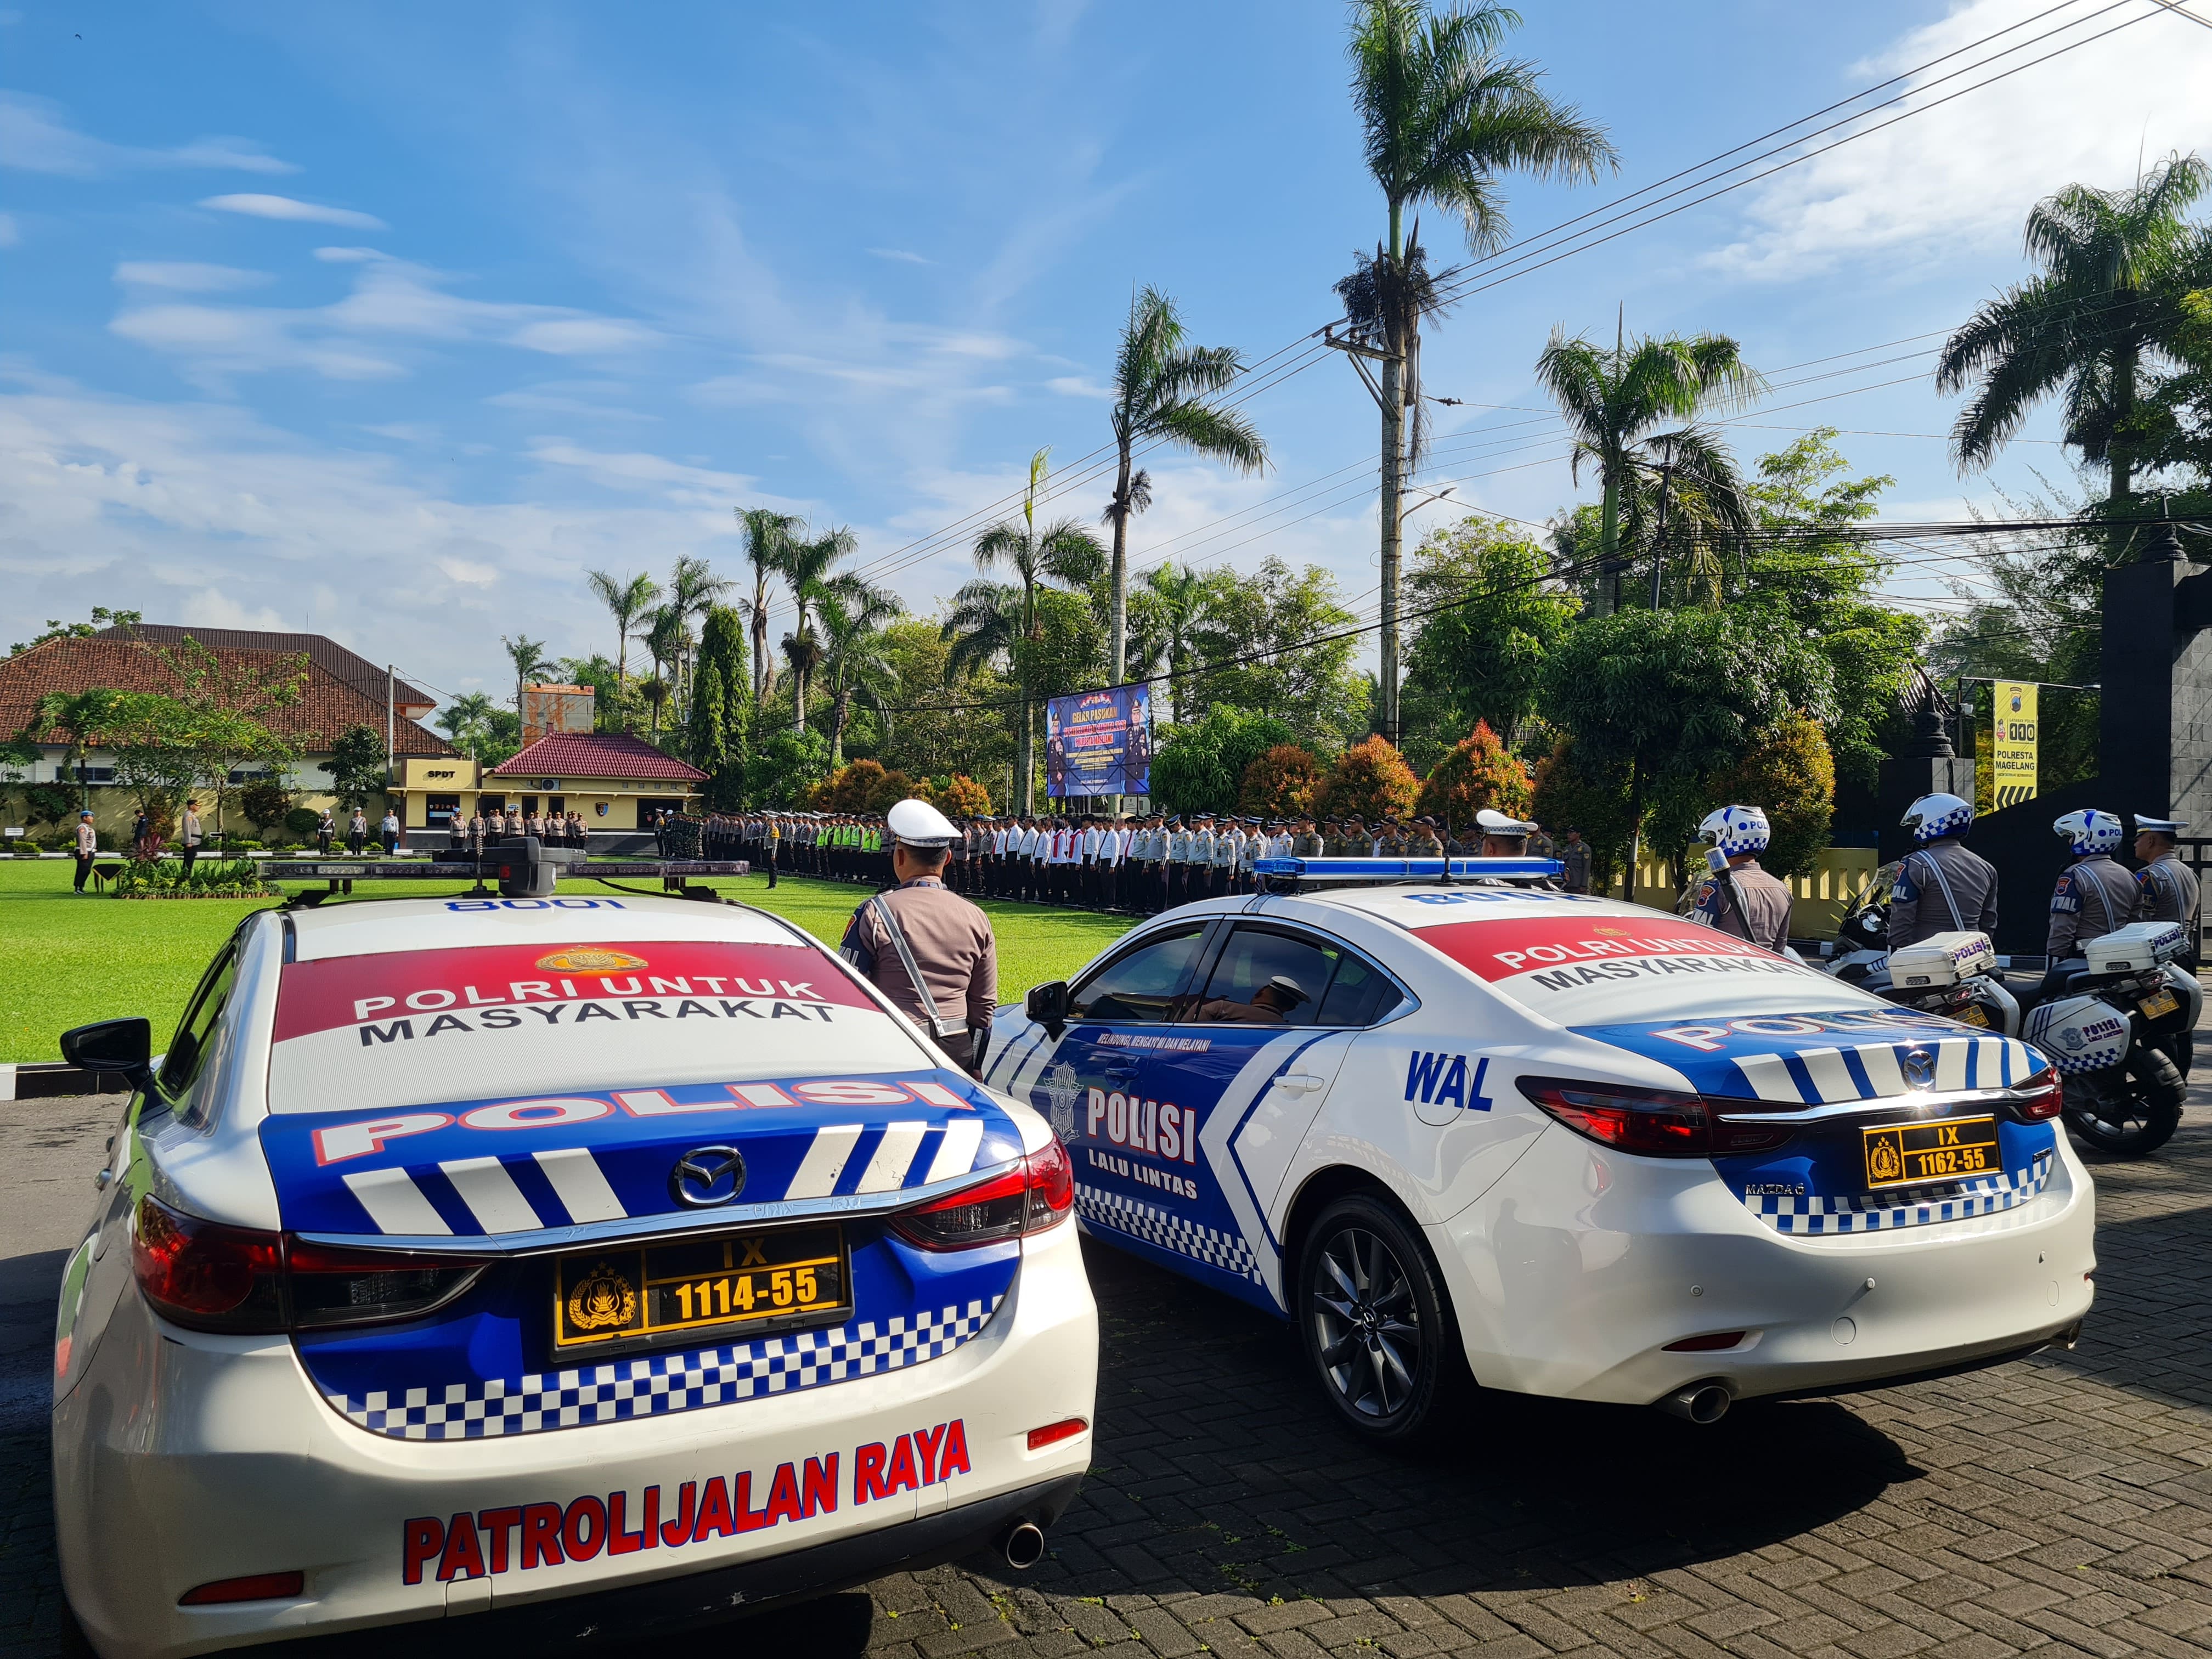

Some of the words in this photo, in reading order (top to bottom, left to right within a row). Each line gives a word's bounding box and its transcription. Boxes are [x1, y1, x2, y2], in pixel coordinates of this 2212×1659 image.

[1073, 710, 1090, 723] GELAR
[1091, 706, 1118, 721] PASUKAN
[2010, 724, 2034, 741] 110
[1995, 761, 2035, 770] MAGELANG
[1997, 751, 2033, 760] POLRESTA
[444, 899, 627, 911] 8001
[1492, 939, 1635, 970] POLRI
[1628, 938, 1775, 958] UNTUK
[1954, 937, 1987, 961] POLISI
[1530, 957, 1814, 991] MASYARAKAT
[353, 977, 578, 1022] POLRI
[603, 975, 826, 1001] UNTUK
[358, 1000, 837, 1048] MASYARAKAT
[2083, 1018, 2121, 1037] POLISI
[1131, 1035, 1166, 1049] MENGAYOMI
[1164, 1037, 1180, 1049] DAN
[1178, 1038, 1211, 1052] MELAYANI
[1405, 1050, 1493, 1113] WAL
[311, 1081, 977, 1167] POLISI
[1087, 1086, 1197, 1165] POLISI
[1938, 1126, 1960, 1146] IX
[1088, 1148, 1129, 1177] LALU
[1133, 1163, 1198, 1199] LINTAS
[1918, 1148, 1985, 1175] 1162-55
[723, 1238, 768, 1268] IX
[675, 1267, 817, 1319] 1114-55
[854, 1418, 971, 1506] RAYA
